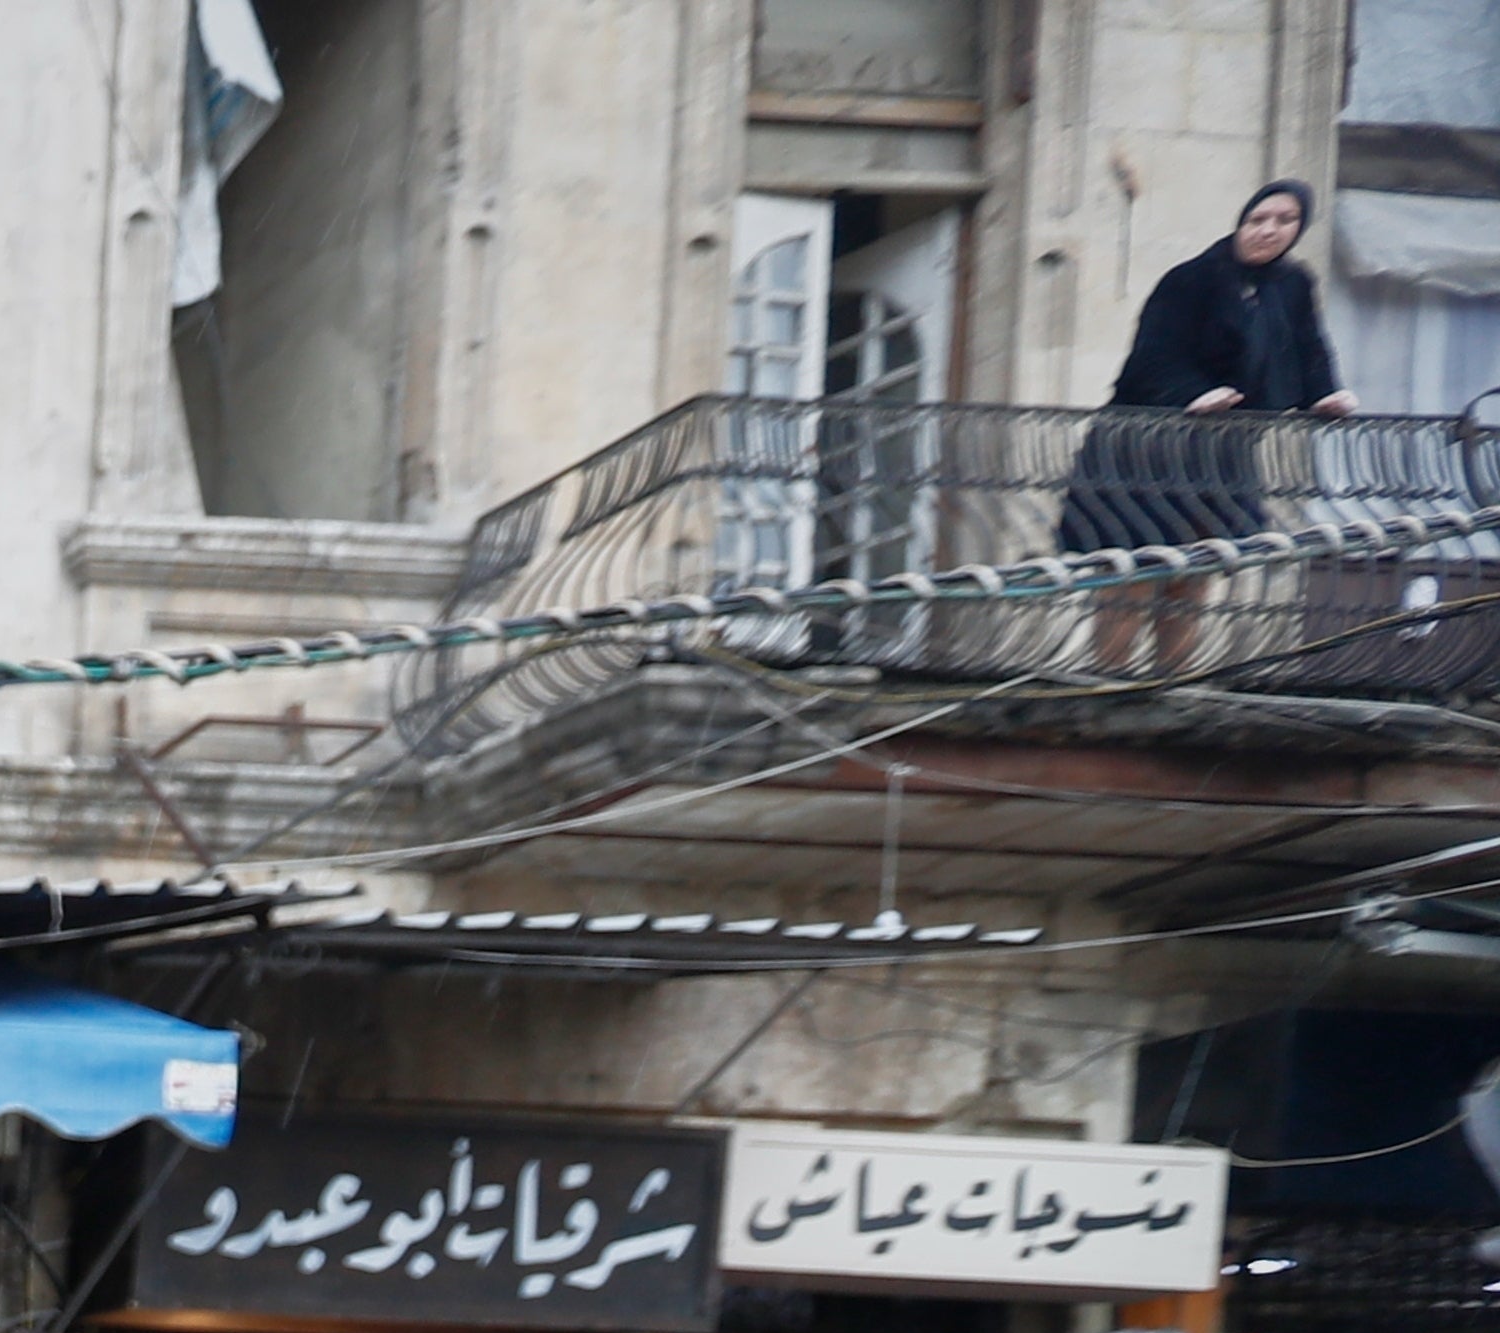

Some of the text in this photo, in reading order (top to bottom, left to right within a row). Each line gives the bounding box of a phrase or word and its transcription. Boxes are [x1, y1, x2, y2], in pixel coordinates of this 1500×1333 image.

[166, 1136, 697, 1299] شرقيات أبو عبدو
